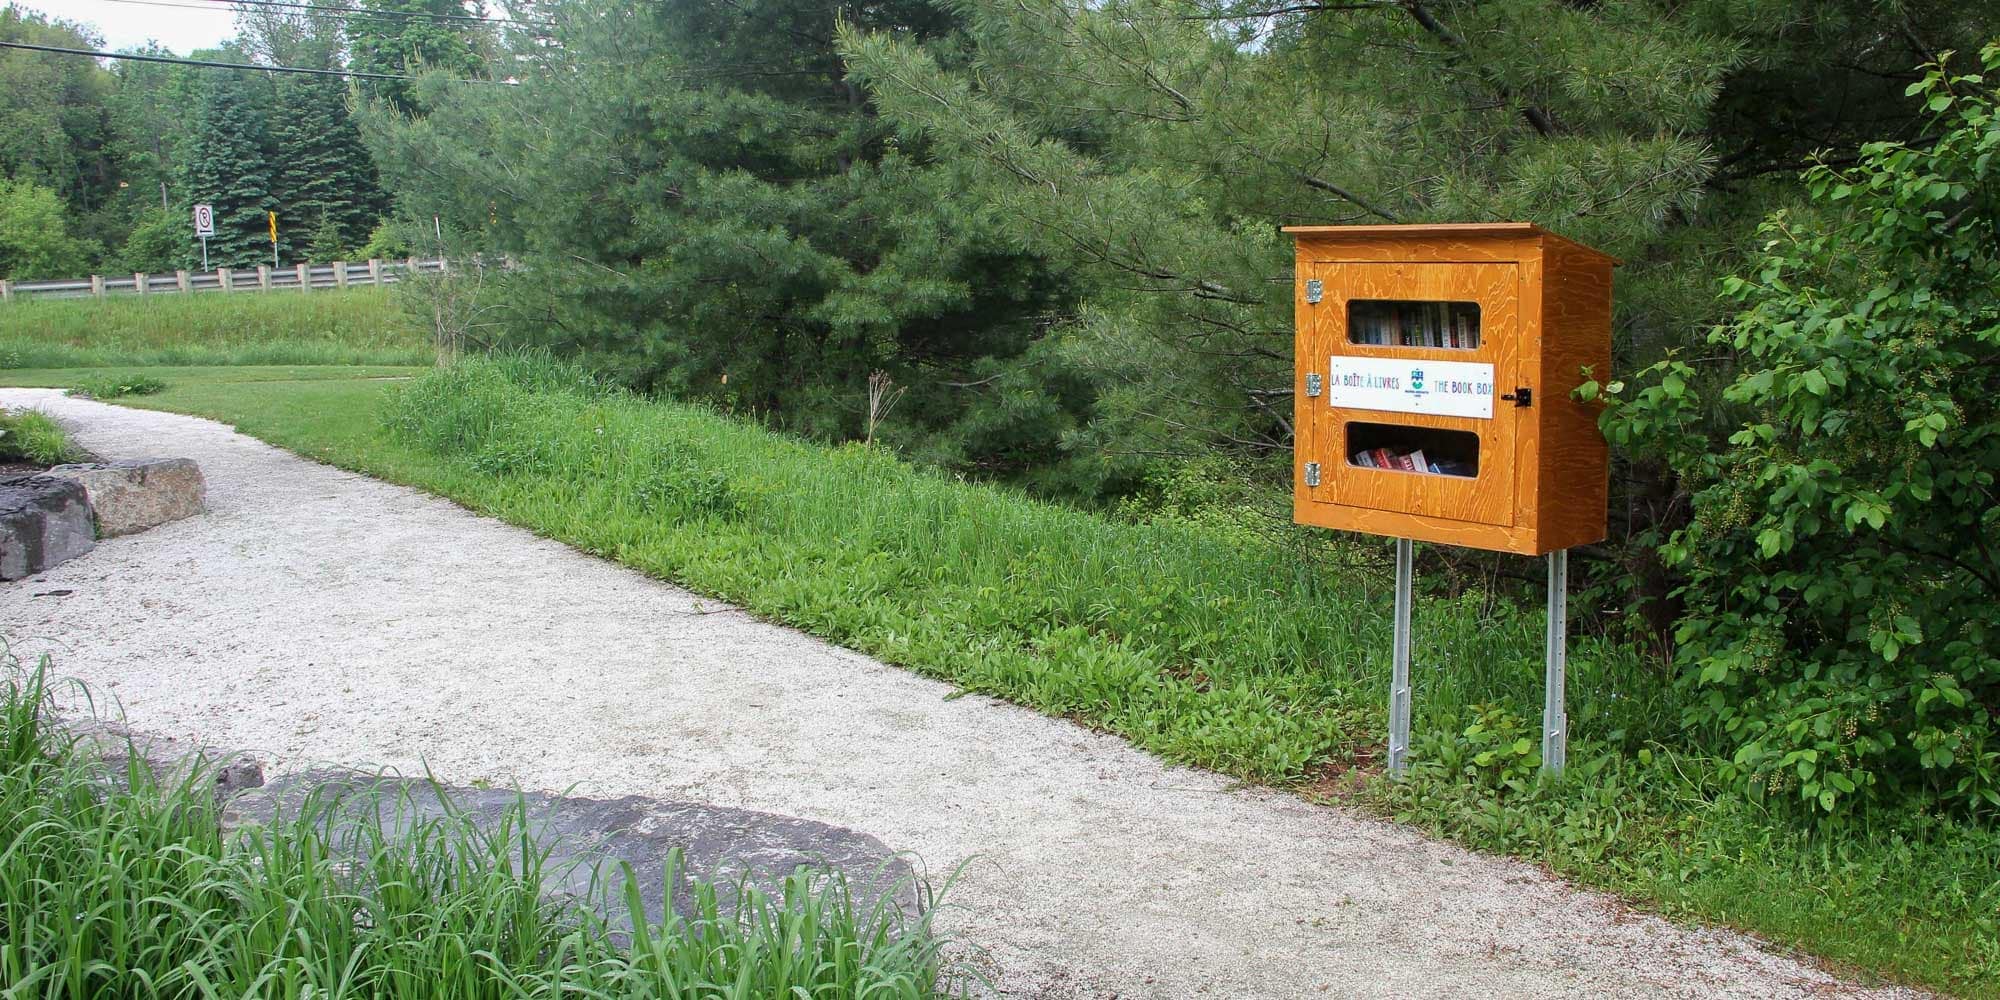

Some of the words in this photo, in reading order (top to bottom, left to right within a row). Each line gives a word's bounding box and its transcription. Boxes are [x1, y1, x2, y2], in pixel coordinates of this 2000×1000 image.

[1331, 374, 1340, 386] LA
[1343, 372, 1364, 388] BOÎTE
[1366, 373, 1372, 388] À
[1374, 376, 1400, 390] LIVRES
[1434, 381, 1449, 393] THE
[1451, 381, 1473, 394] BOOK
[1476, 382, 1493, 395] BOX
